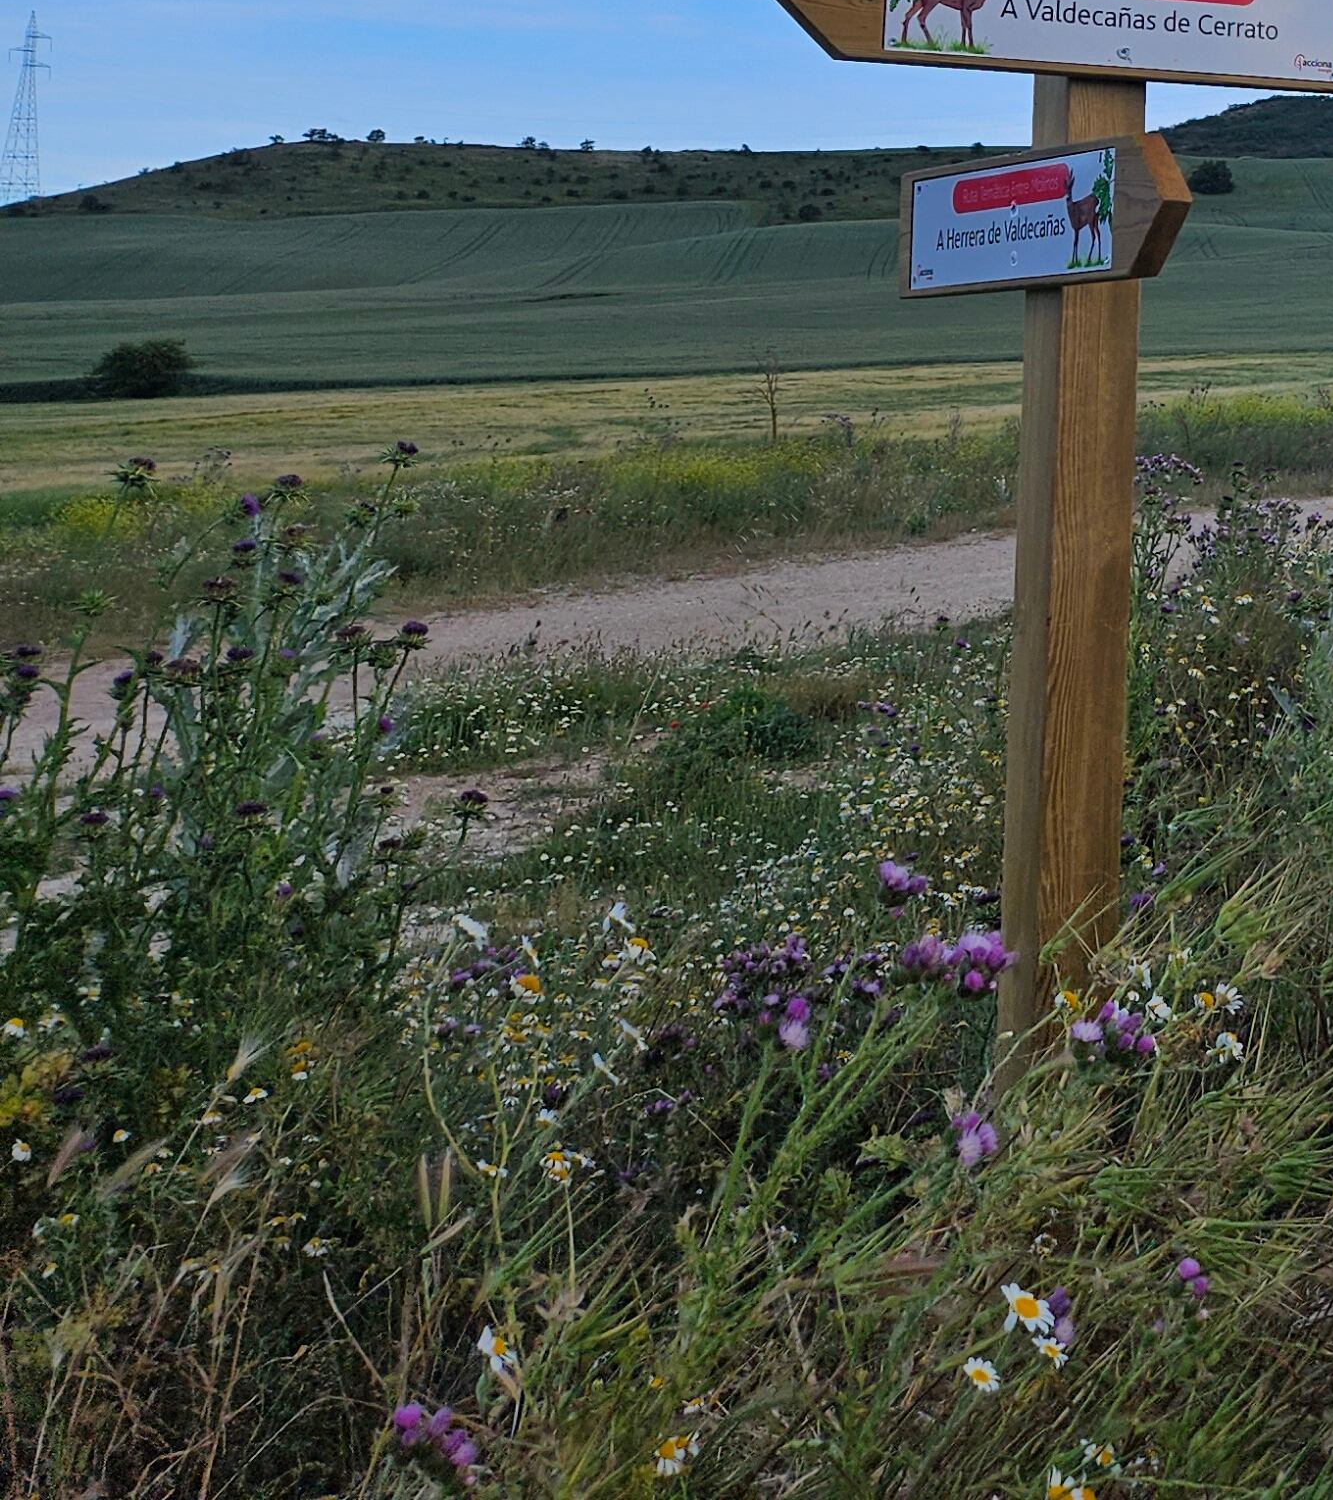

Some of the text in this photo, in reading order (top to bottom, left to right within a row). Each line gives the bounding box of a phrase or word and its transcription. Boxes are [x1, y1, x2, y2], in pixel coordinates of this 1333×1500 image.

[1163, 10, 1190, 34] de
[1198, 14, 1279, 41] Cerrato
[936, 214, 1066, 251] A Herrera de Valdecañas
